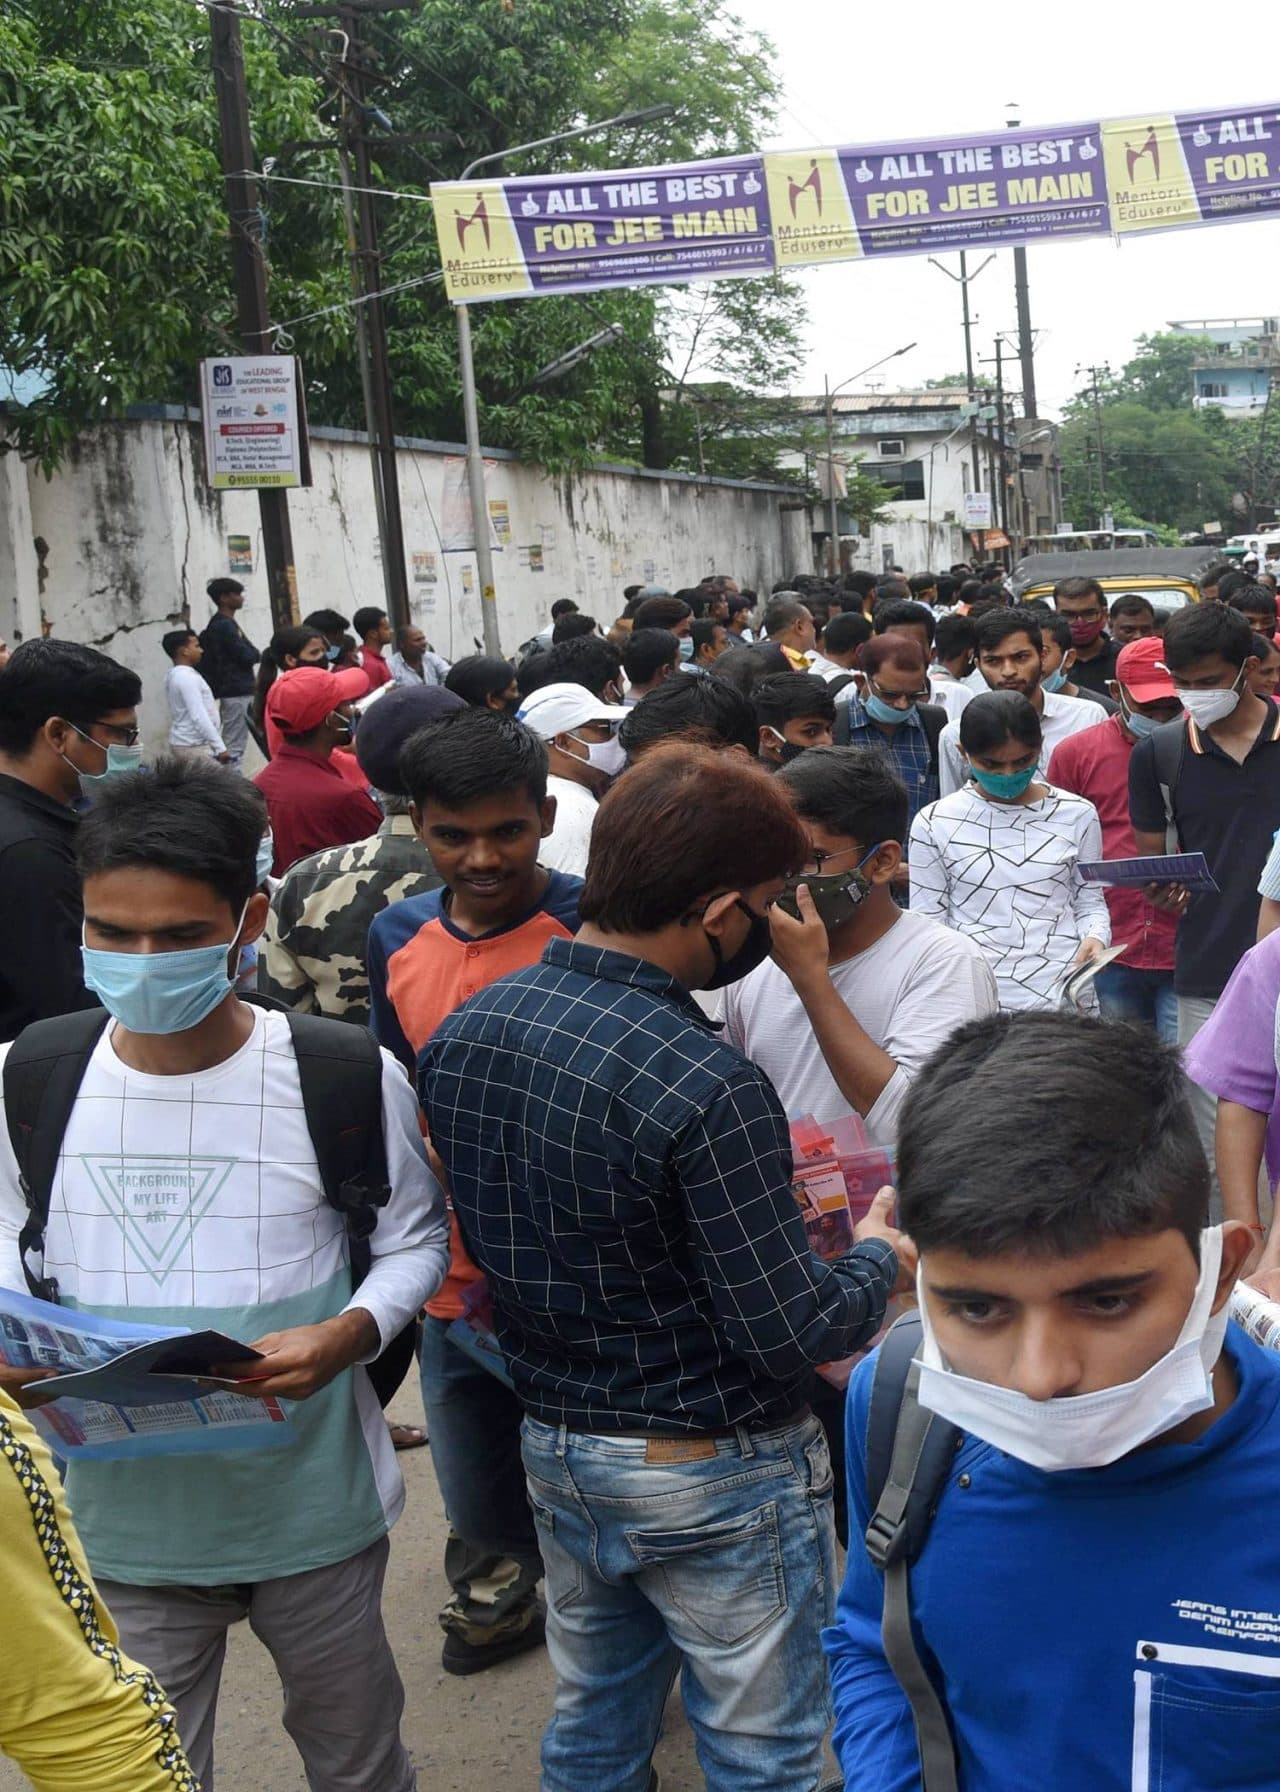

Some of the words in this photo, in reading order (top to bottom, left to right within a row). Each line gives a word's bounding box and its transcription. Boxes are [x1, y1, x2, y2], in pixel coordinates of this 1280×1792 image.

[1218, 116, 1272, 145] ALL
[880, 154, 932, 180] ALL
[938, 146, 994, 175] THE
[1000, 138, 1074, 169] BEST
[1206, 152, 1269, 183] FOR
[546, 188, 599, 214] ALL
[603, 181, 659, 208] THE
[665, 174, 738, 202] BEST
[866, 190, 930, 219] FOR
[939, 182, 998, 212] JEE
[1007, 172, 1093, 205] MAIN
[1116, 187, 1182, 204] Mentors
[534, 222, 597, 252] FOR
[606, 216, 664, 246] JEE
[672, 206, 758, 238] MAIN
[778, 223, 842, 238] Mentors
[448, 256, 510, 271] Mentors
[253, 368, 283, 376] LEADING
[117, 1174, 196, 1190] BACKGROUND
[134, 1193, 150, 1206] MY
[155, 1192, 179, 1206] LIFE
[146, 1210, 168, 1224] ART
[1171, 1599, 1227, 1616] JEANS
[1179, 1610, 1231, 1626] DENIM
